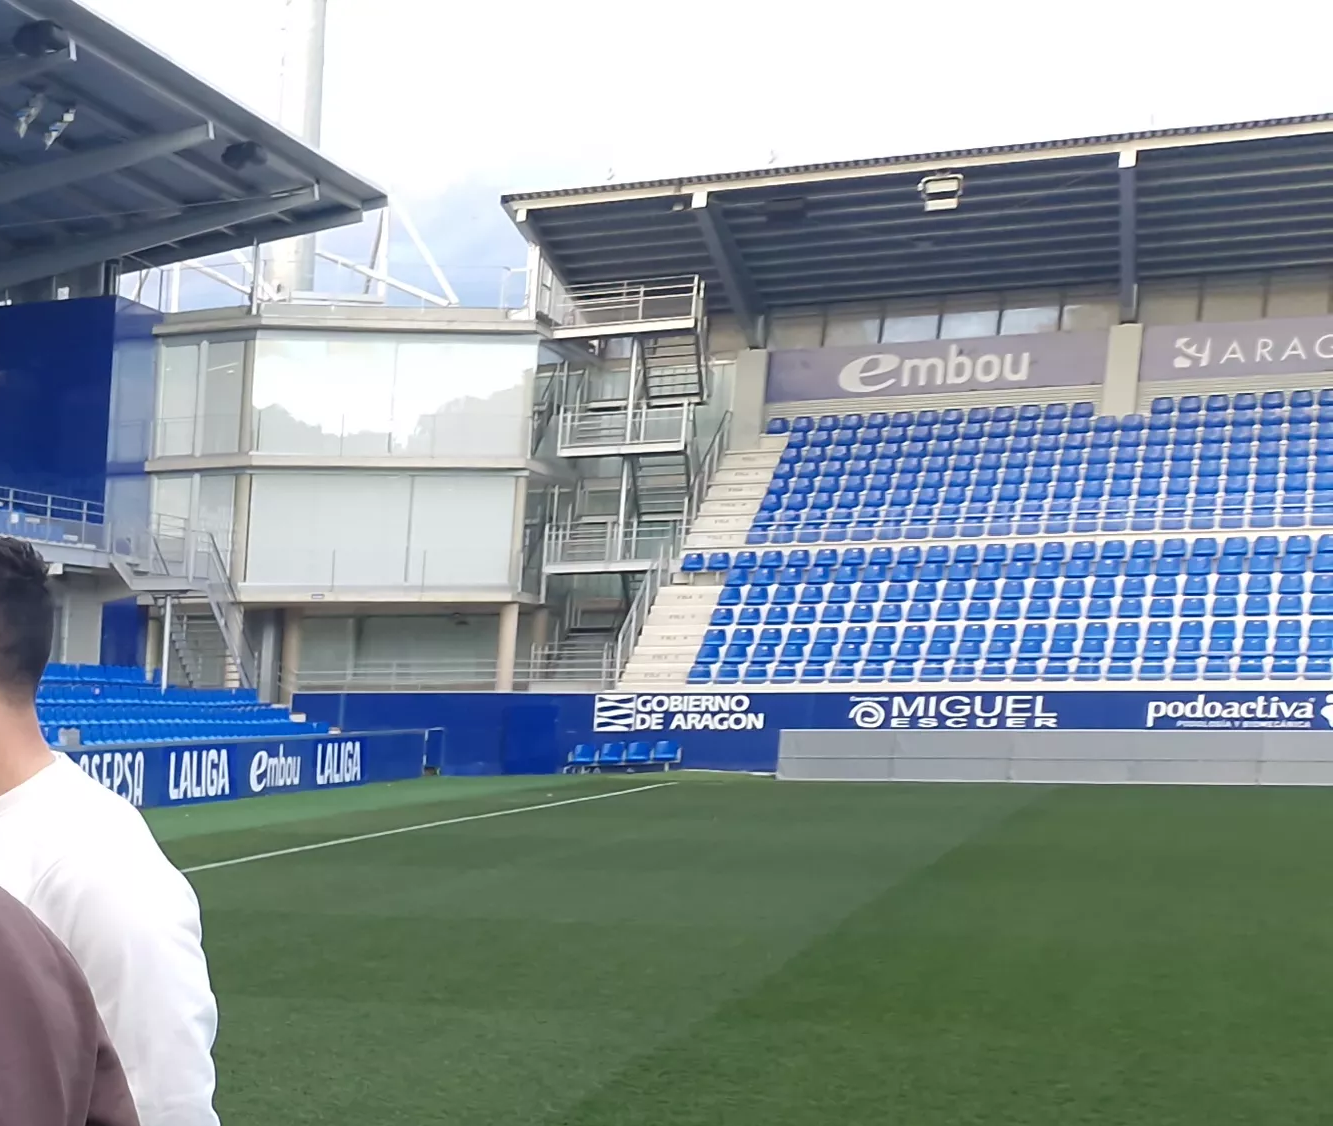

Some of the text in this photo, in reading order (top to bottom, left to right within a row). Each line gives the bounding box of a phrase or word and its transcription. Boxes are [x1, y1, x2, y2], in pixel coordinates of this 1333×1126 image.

[838, 344, 1031, 393] embou
[637, 695, 751, 712] GOBIERNO
[891, 695, 1058, 717] MIGUEL
[1146, 694, 1315, 728] podoactiva
[635, 713, 765, 730] DE ARAGON
[890, 718, 1058, 728] ESCUER
[169, 749, 230, 800] LALIGA
[250, 743, 301, 792] embou
[316, 741, 361, 785] LALIGA
